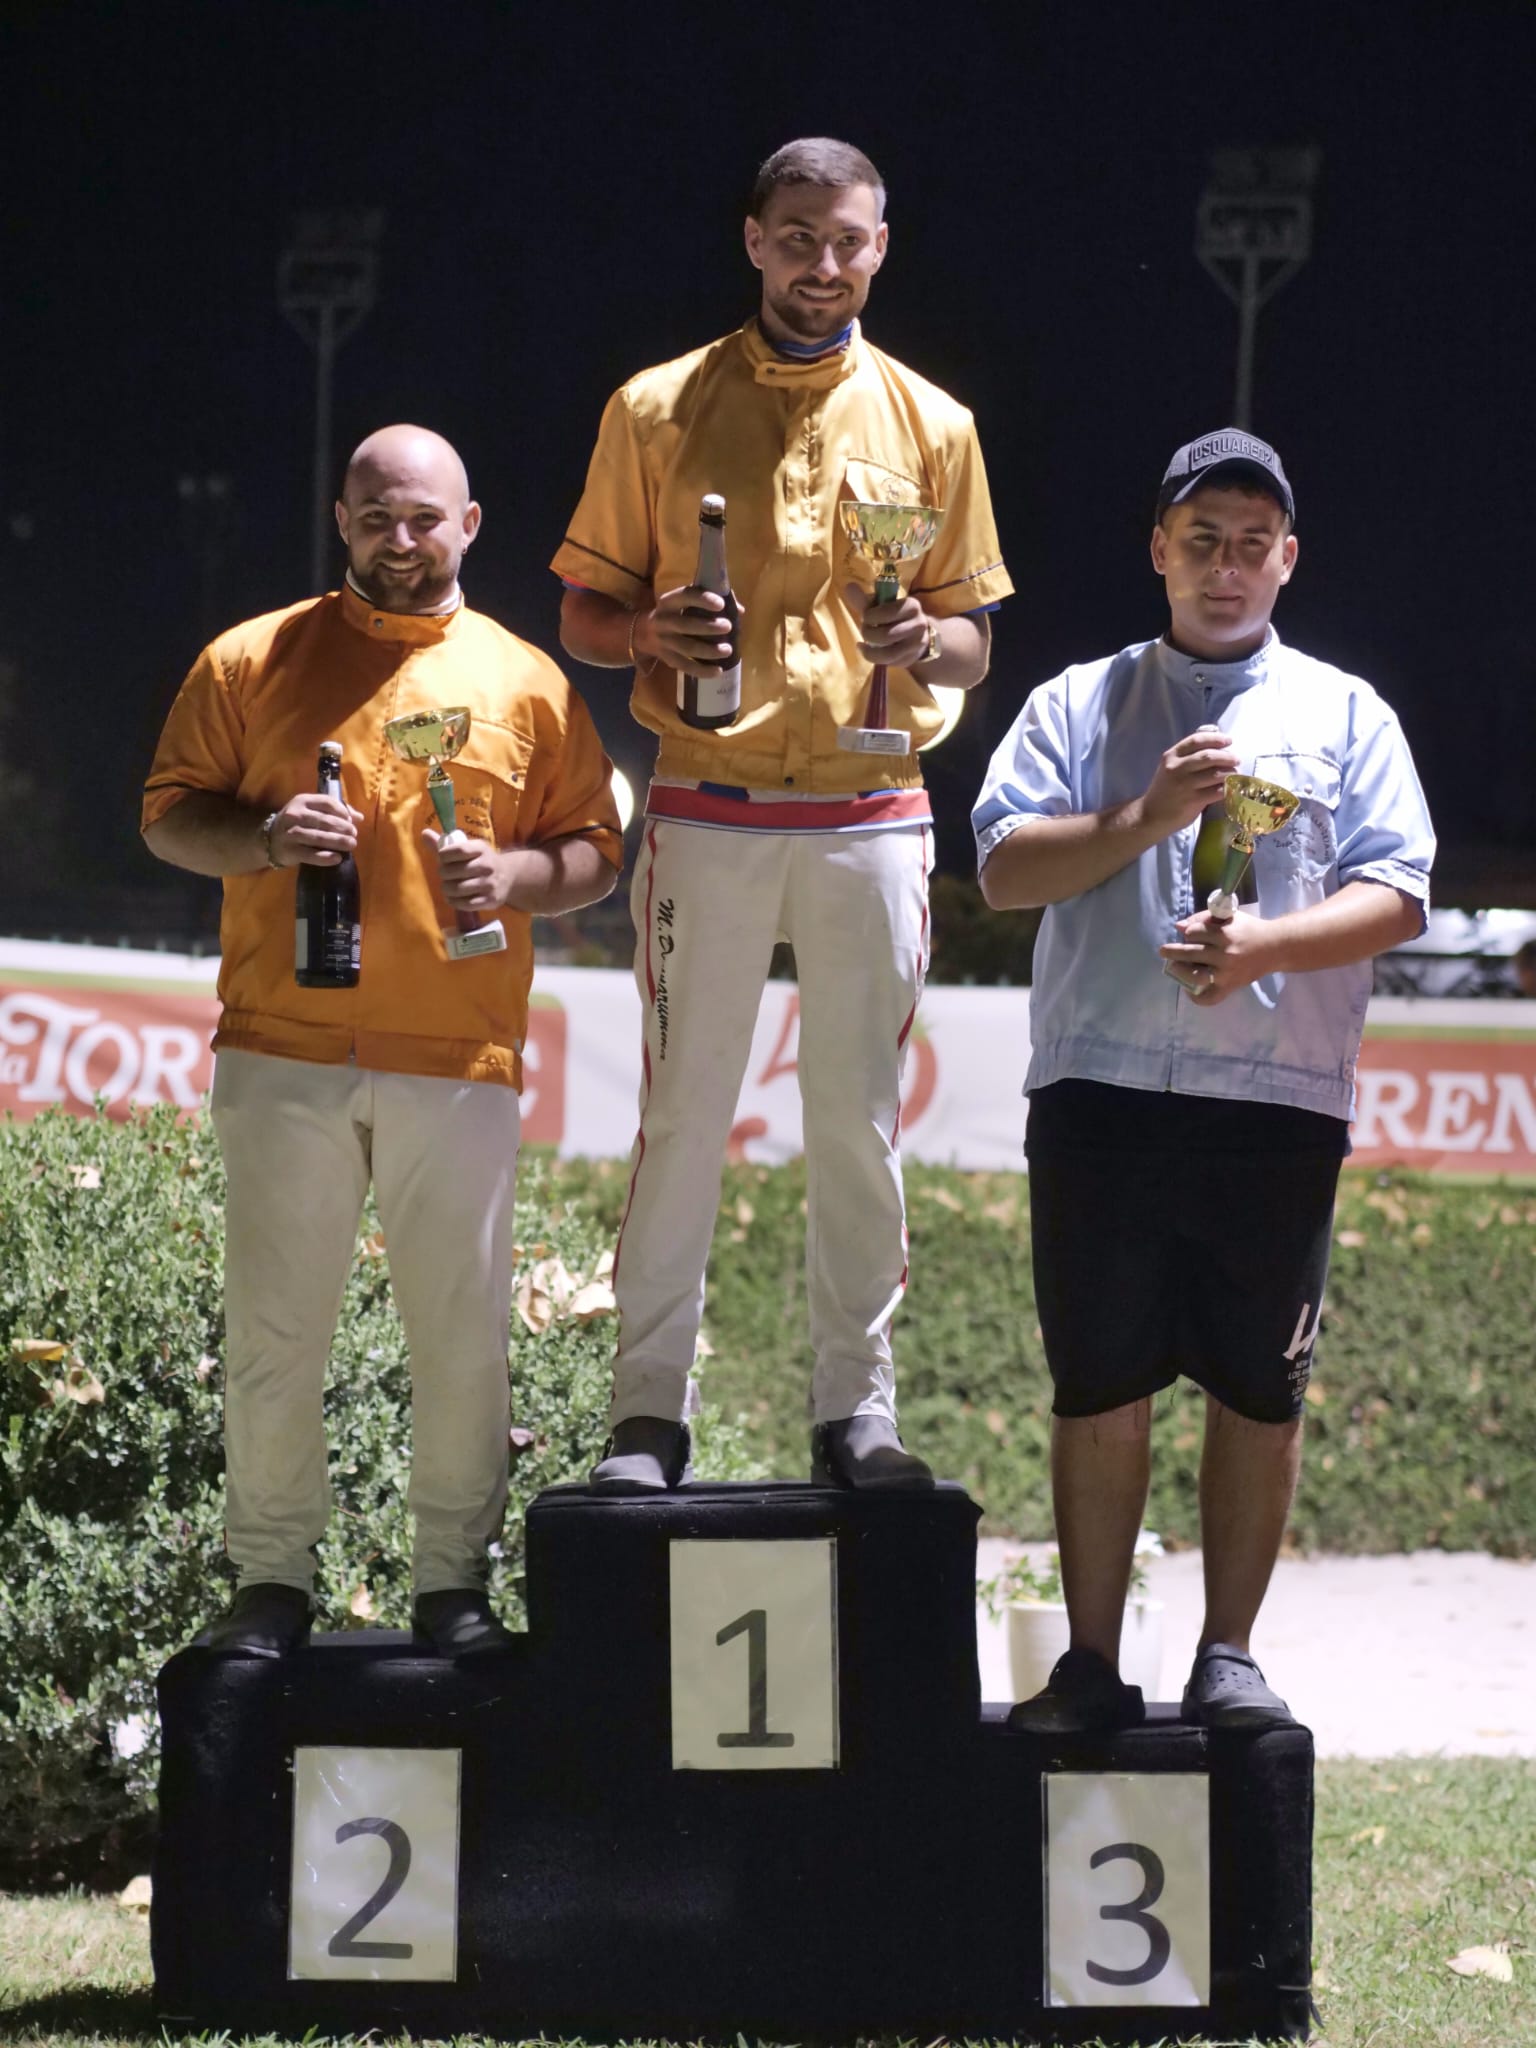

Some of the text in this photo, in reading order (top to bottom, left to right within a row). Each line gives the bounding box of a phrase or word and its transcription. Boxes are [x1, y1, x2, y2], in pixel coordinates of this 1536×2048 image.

[0, 992, 216, 1108] TOR
[716, 1609, 795, 1748] 1
[328, 1817, 413, 1959] 2
[1086, 1842, 1171, 1985] 3
